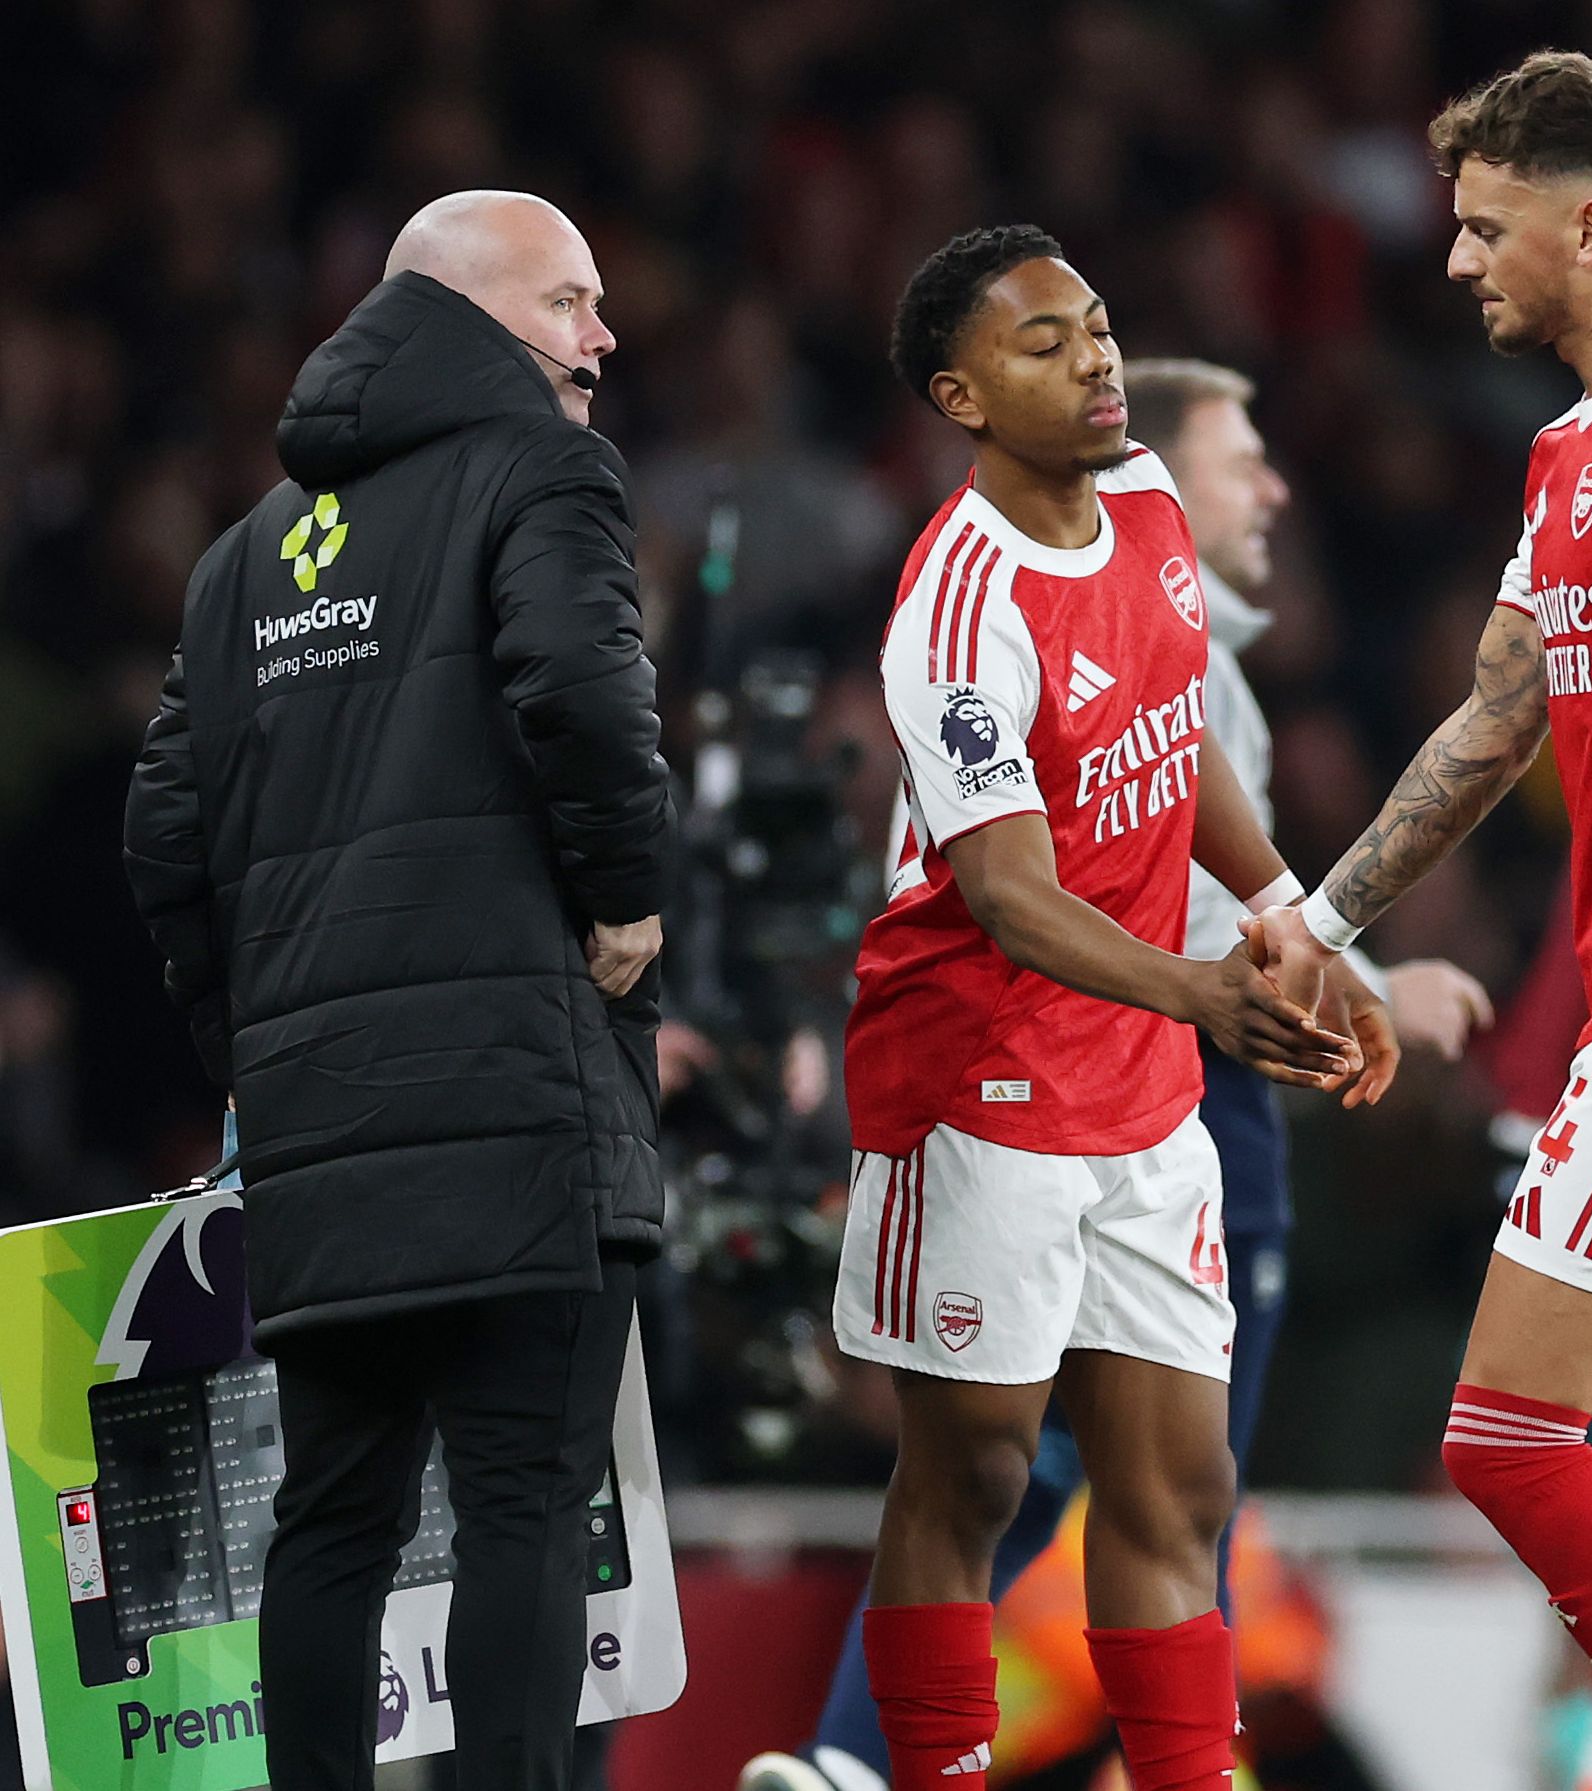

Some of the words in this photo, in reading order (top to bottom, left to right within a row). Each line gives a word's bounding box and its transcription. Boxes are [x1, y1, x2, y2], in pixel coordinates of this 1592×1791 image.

[254, 595, 378, 651] HuwsGray
[304, 640, 380, 670] Supplies
[1075, 674, 1205, 808] Emirat
[953, 769, 974, 784] No
[1095, 779, 1140, 843] FLY
[1537, 1076, 1589, 1178] 4
[1189, 1201, 1226, 1300] 4
[940, 1300, 976, 1315] Arsenal
